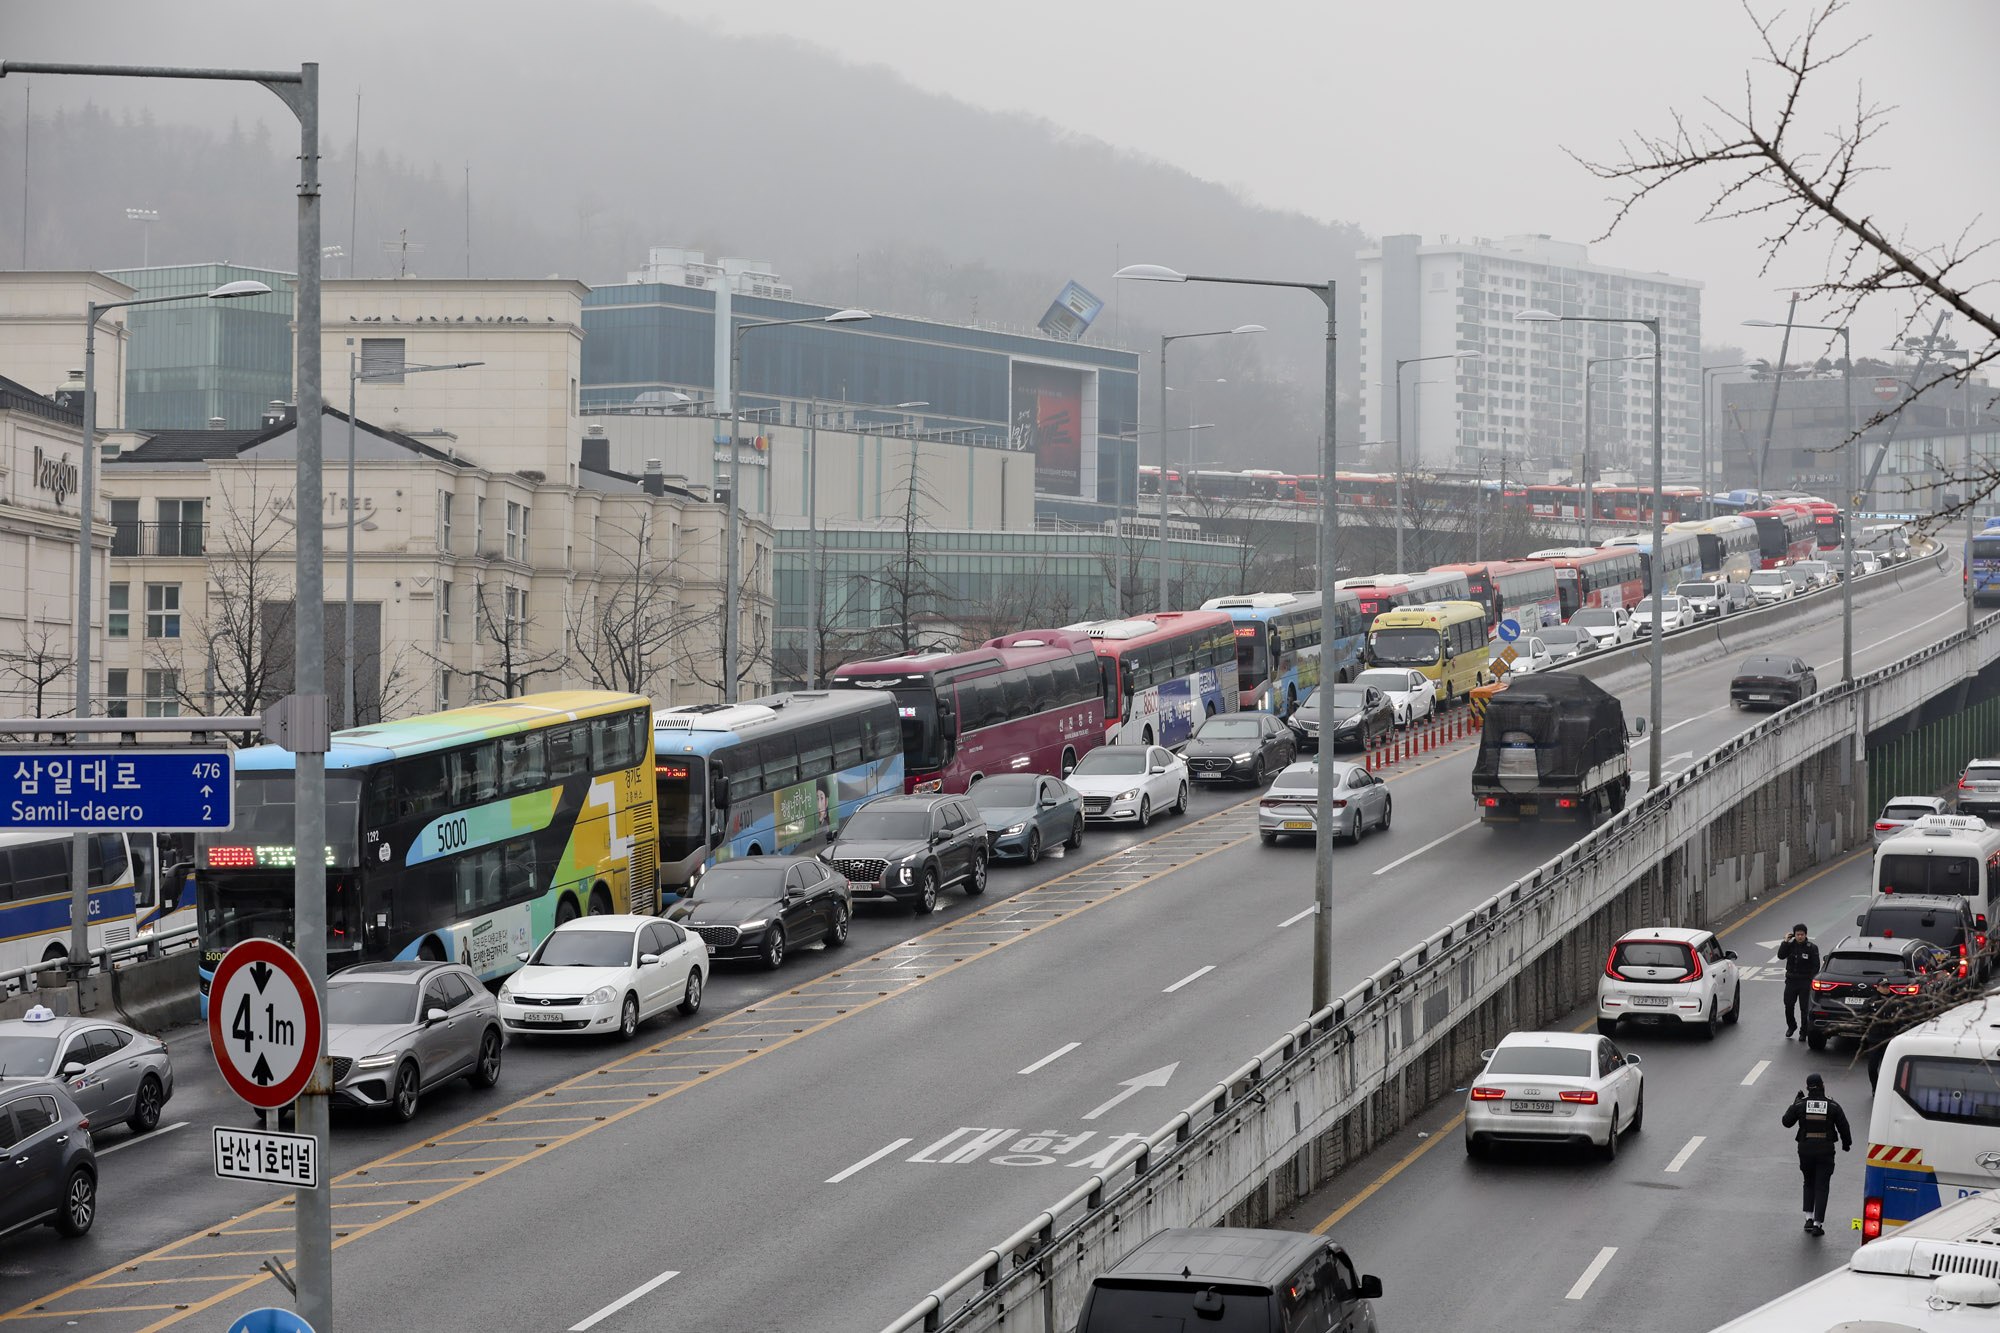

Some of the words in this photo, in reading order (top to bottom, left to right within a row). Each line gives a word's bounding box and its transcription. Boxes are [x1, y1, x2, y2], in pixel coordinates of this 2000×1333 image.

[33, 445, 79, 505] Paragon
[273, 492, 373, 516] HATREE
[1143, 690, 1159, 715] 8800
[13, 760, 142, 795] 삼일대로
[192, 762, 221, 779] 476
[625, 767, 642, 789] 경기도
[11, 800, 144, 822] Samil-daero
[202, 804, 212, 821] 2
[366, 830, 380, 844] 1292
[437, 817, 468, 852] 5000
[232, 993, 295, 1053] 4.1m
[1532, 1102, 1550, 1110] 1598
[220, 1135, 311, 1180] 남산1호터널
